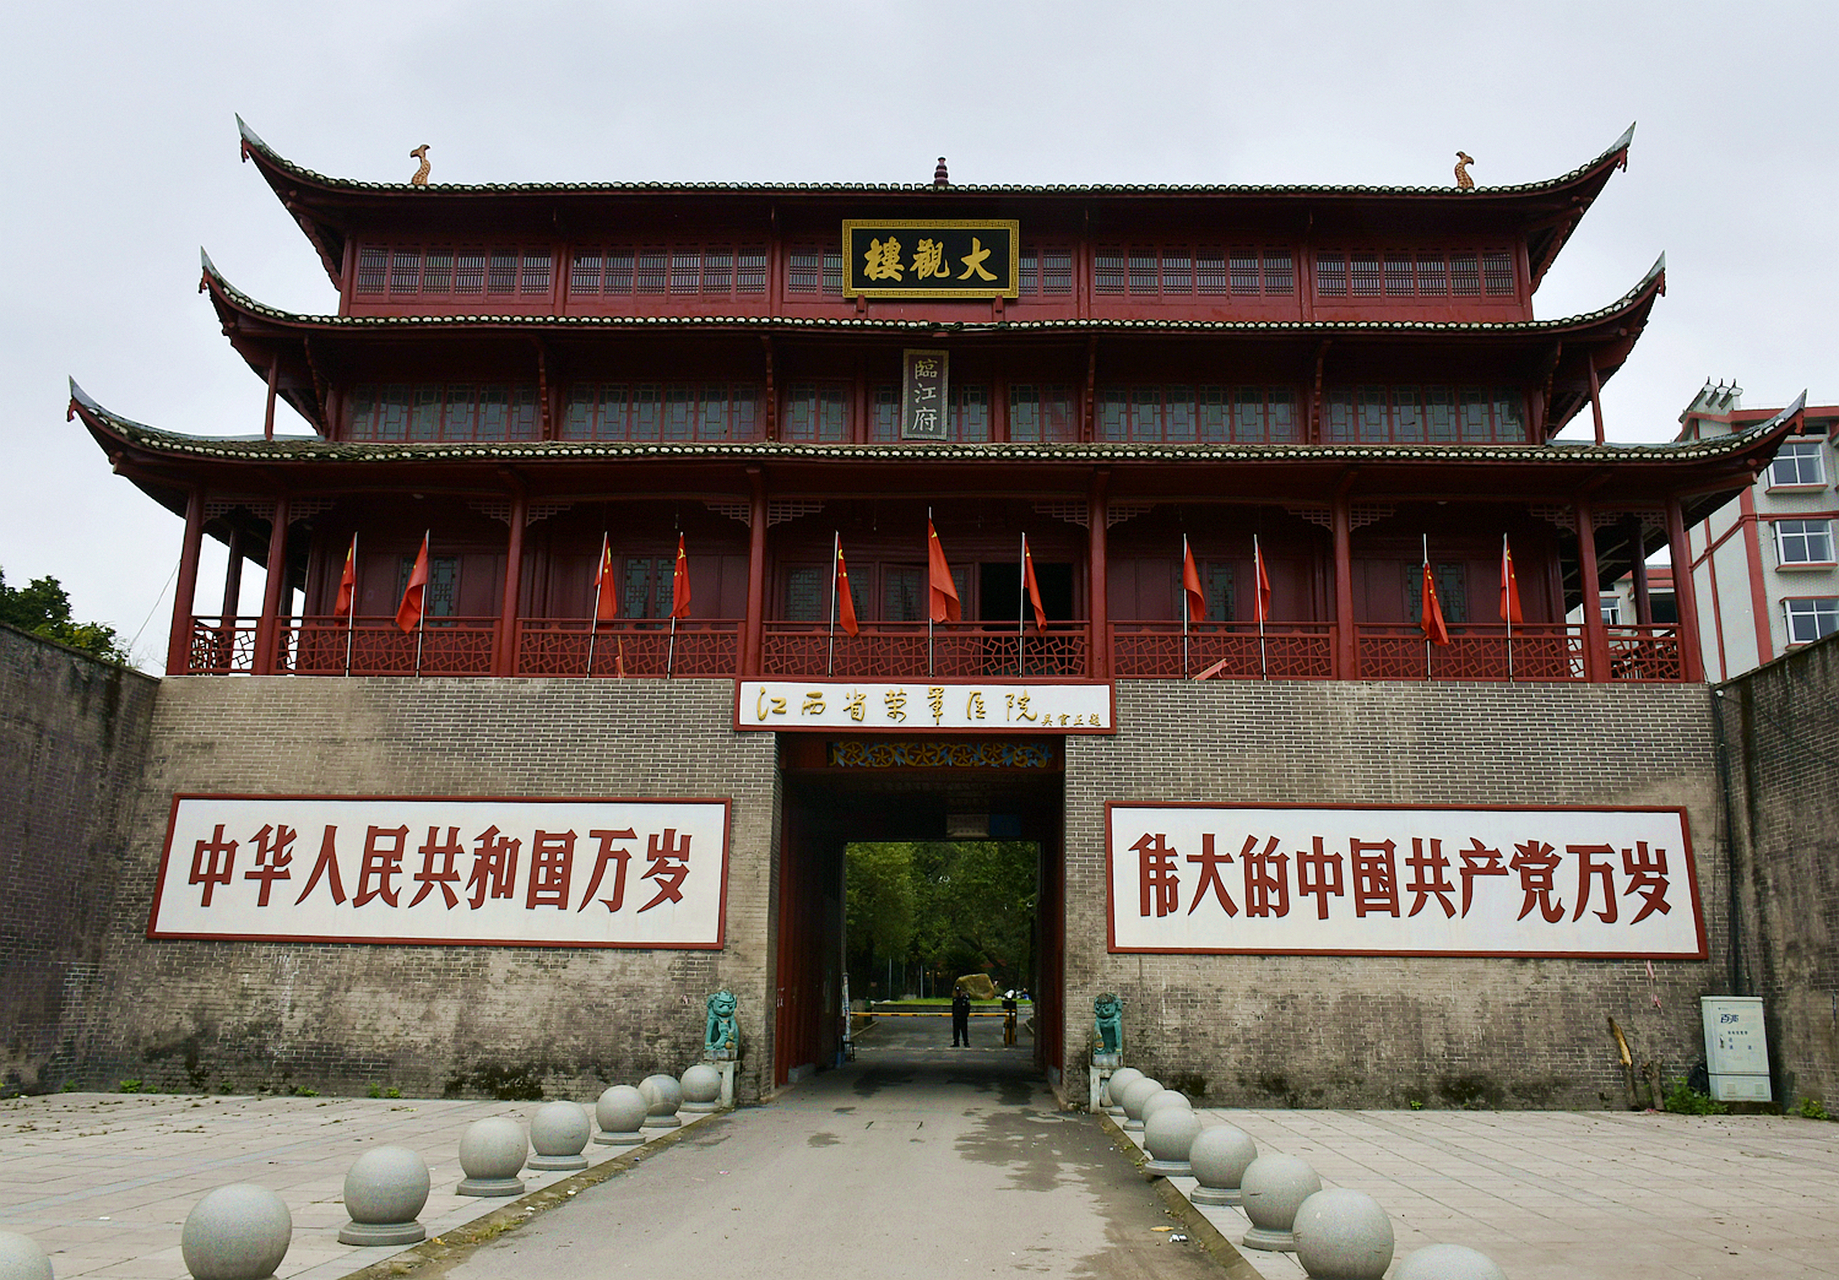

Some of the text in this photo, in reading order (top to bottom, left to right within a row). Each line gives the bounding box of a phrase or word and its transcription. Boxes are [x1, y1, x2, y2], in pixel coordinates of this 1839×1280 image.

[912, 358, 939, 432] 臨江府
[189, 824, 691, 913] 中华人民共和国万岁
[1128, 832, 1672, 925] 伟大的中国共产党万岁
